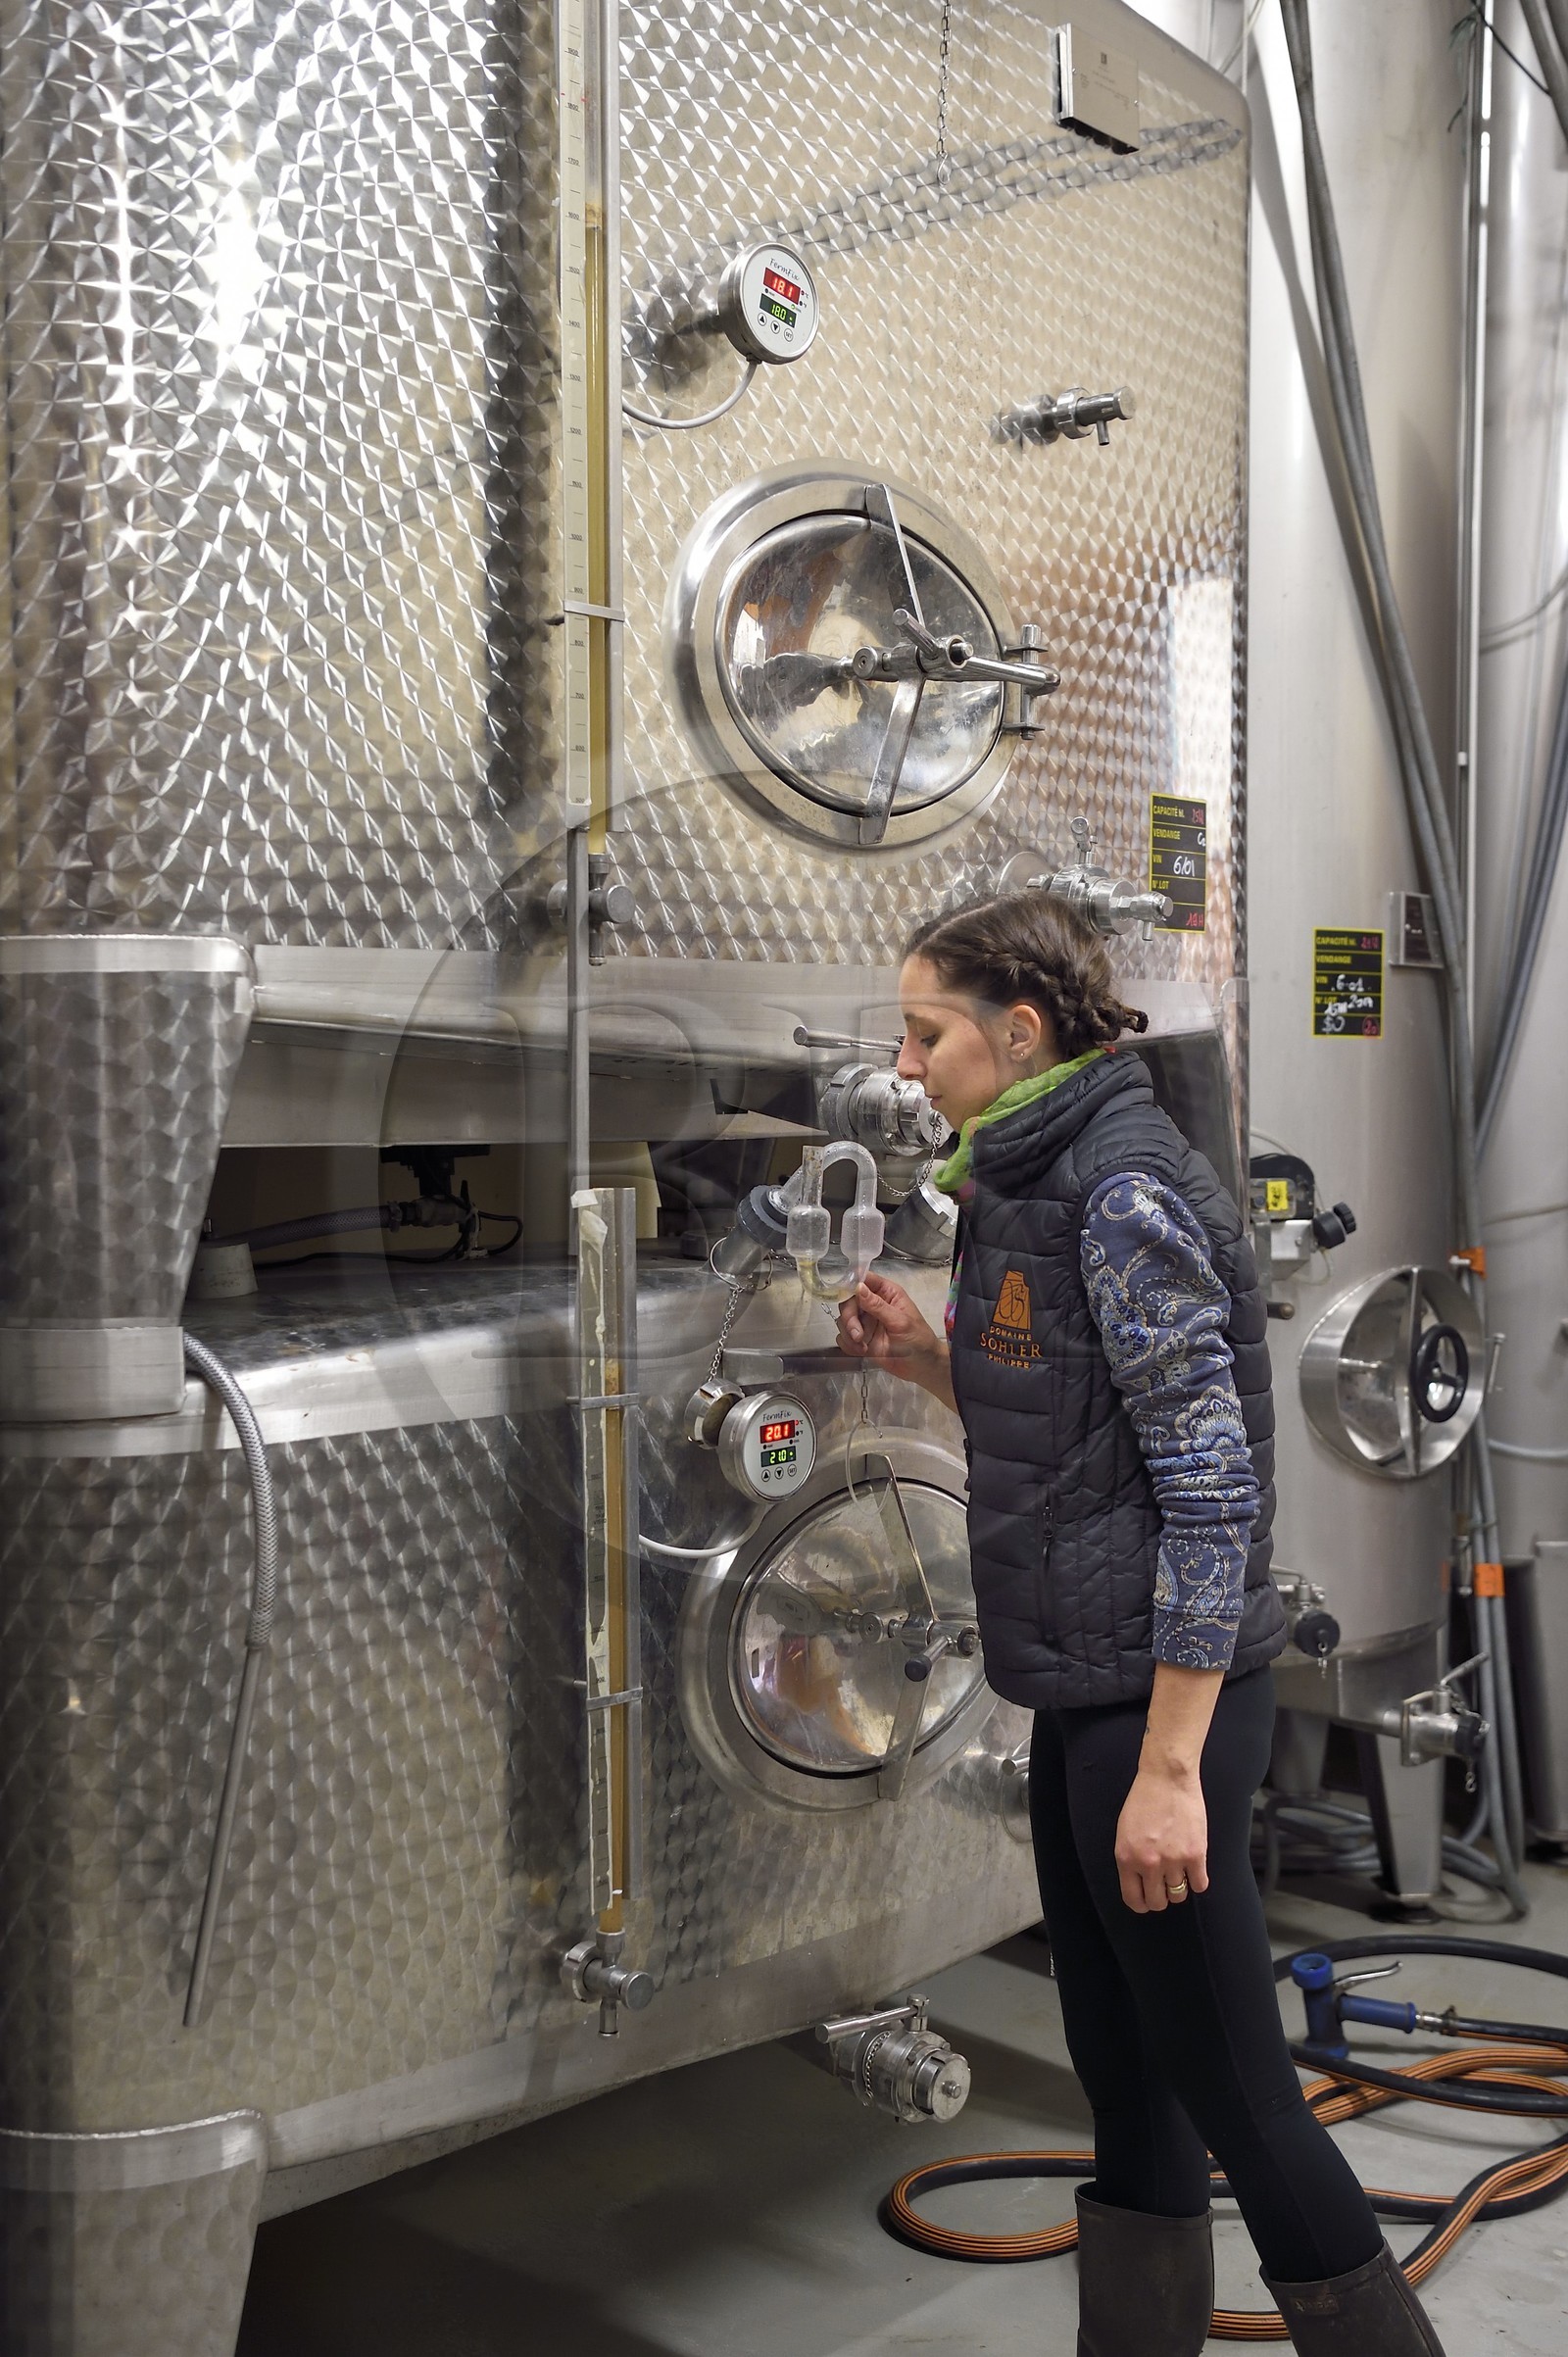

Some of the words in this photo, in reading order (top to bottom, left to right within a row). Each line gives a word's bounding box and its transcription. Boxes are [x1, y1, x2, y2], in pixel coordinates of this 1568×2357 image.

[769, 257, 800, 281] FermFix
[1152, 805, 1178, 817] CAPACITÉ
[1152, 828, 1181, 840] VENDANGE
[1152, 854, 1162, 863] VIN
[1316, 936, 1348, 946] CAPACITÉ
[1315, 954, 1351, 964] VENDANGE
[1315, 975, 1328, 984] VIN
[989, 1325, 1032, 1341] DOMAINE
[980, 1332, 1043, 1358] SOHLER
[988, 1352, 1030, 1369] PHILIPPE
[762, 1410, 792, 1423] FermFix
[764, 1423, 789, 1442] 20.1
